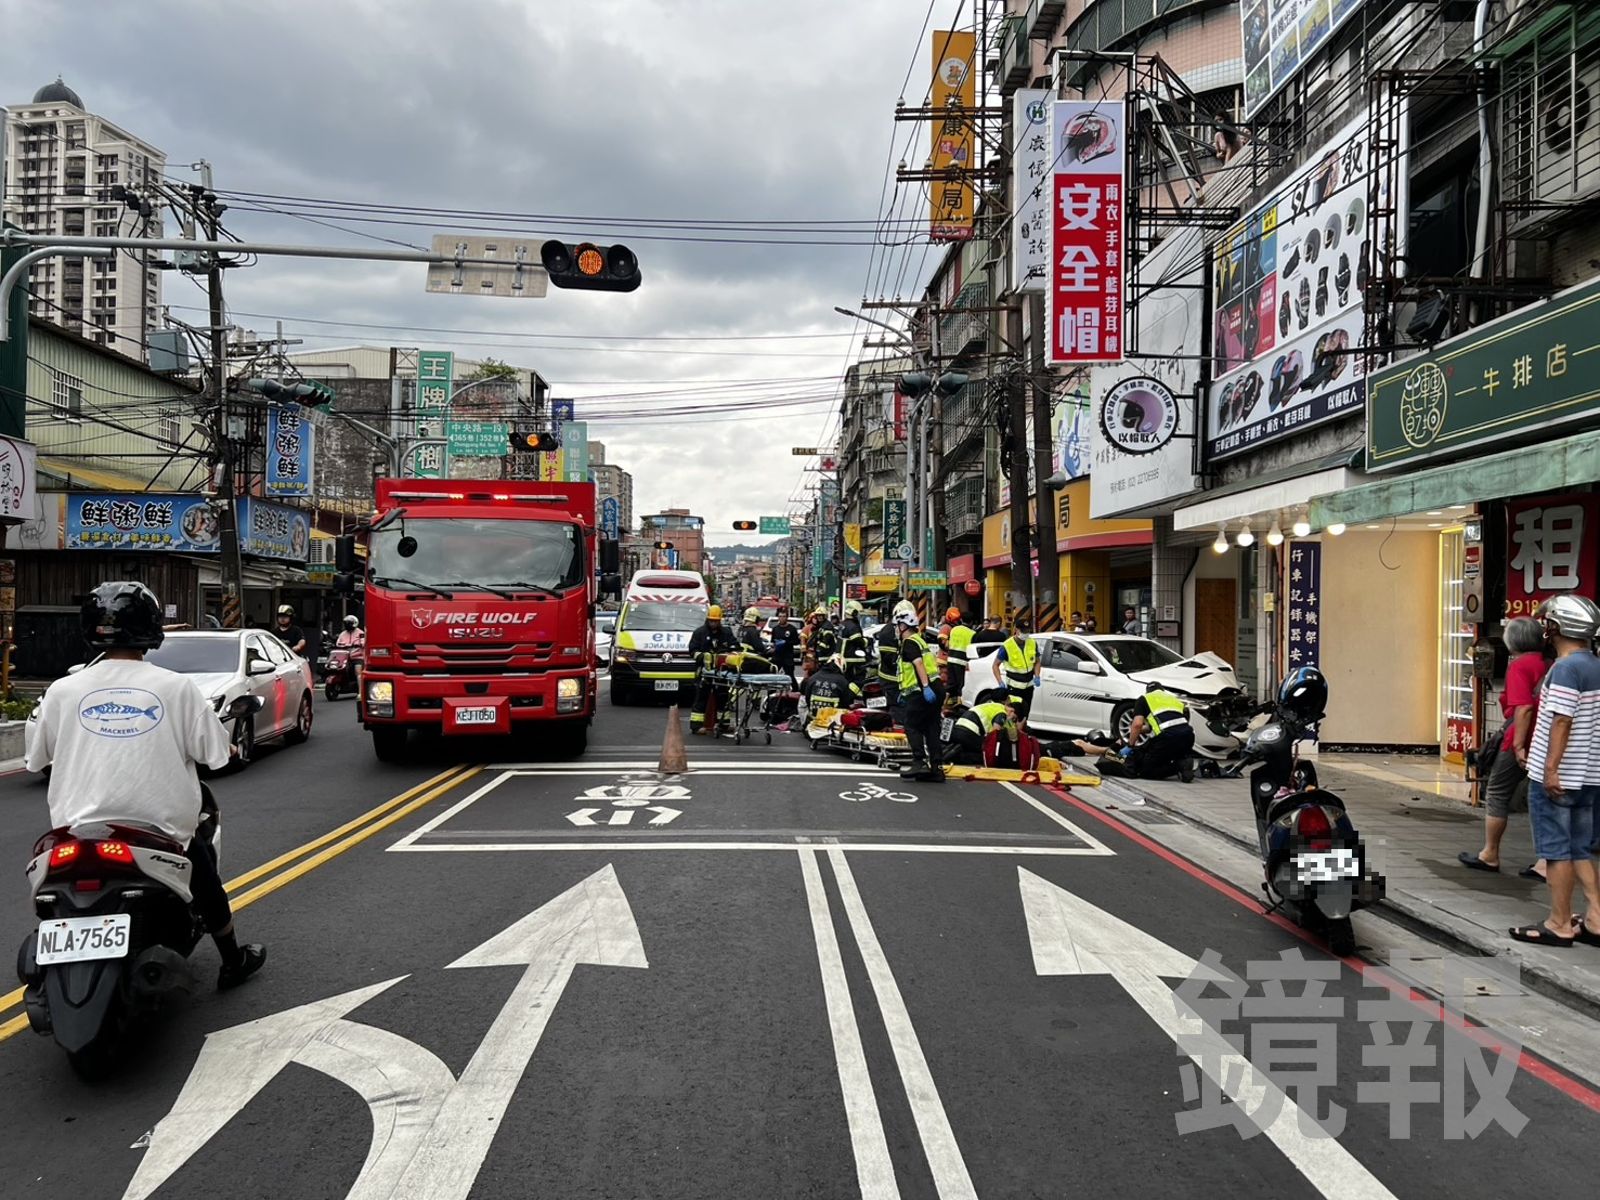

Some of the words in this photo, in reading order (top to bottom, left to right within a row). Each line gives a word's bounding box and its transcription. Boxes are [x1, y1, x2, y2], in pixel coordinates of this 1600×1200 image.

[1059, 182, 1101, 354] 安全帽
[1482, 343, 1567, 397] 牛排店
[418, 357, 447, 470] 王牌榔
[1118, 433, 1161, 443] 以帽取人
[276, 408, 302, 480] 鮮粥鮮
[80, 500, 173, 528] 鮮粥鮮
[1511, 504, 1584, 594] 租
[433, 613, 477, 624] FIRE
[482, 613, 537, 624] WOLF
[448, 628, 504, 638] ISUZU
[1290, 549, 1304, 663] 行車記錄器安
[100, 726, 139, 735] MACKEREL
